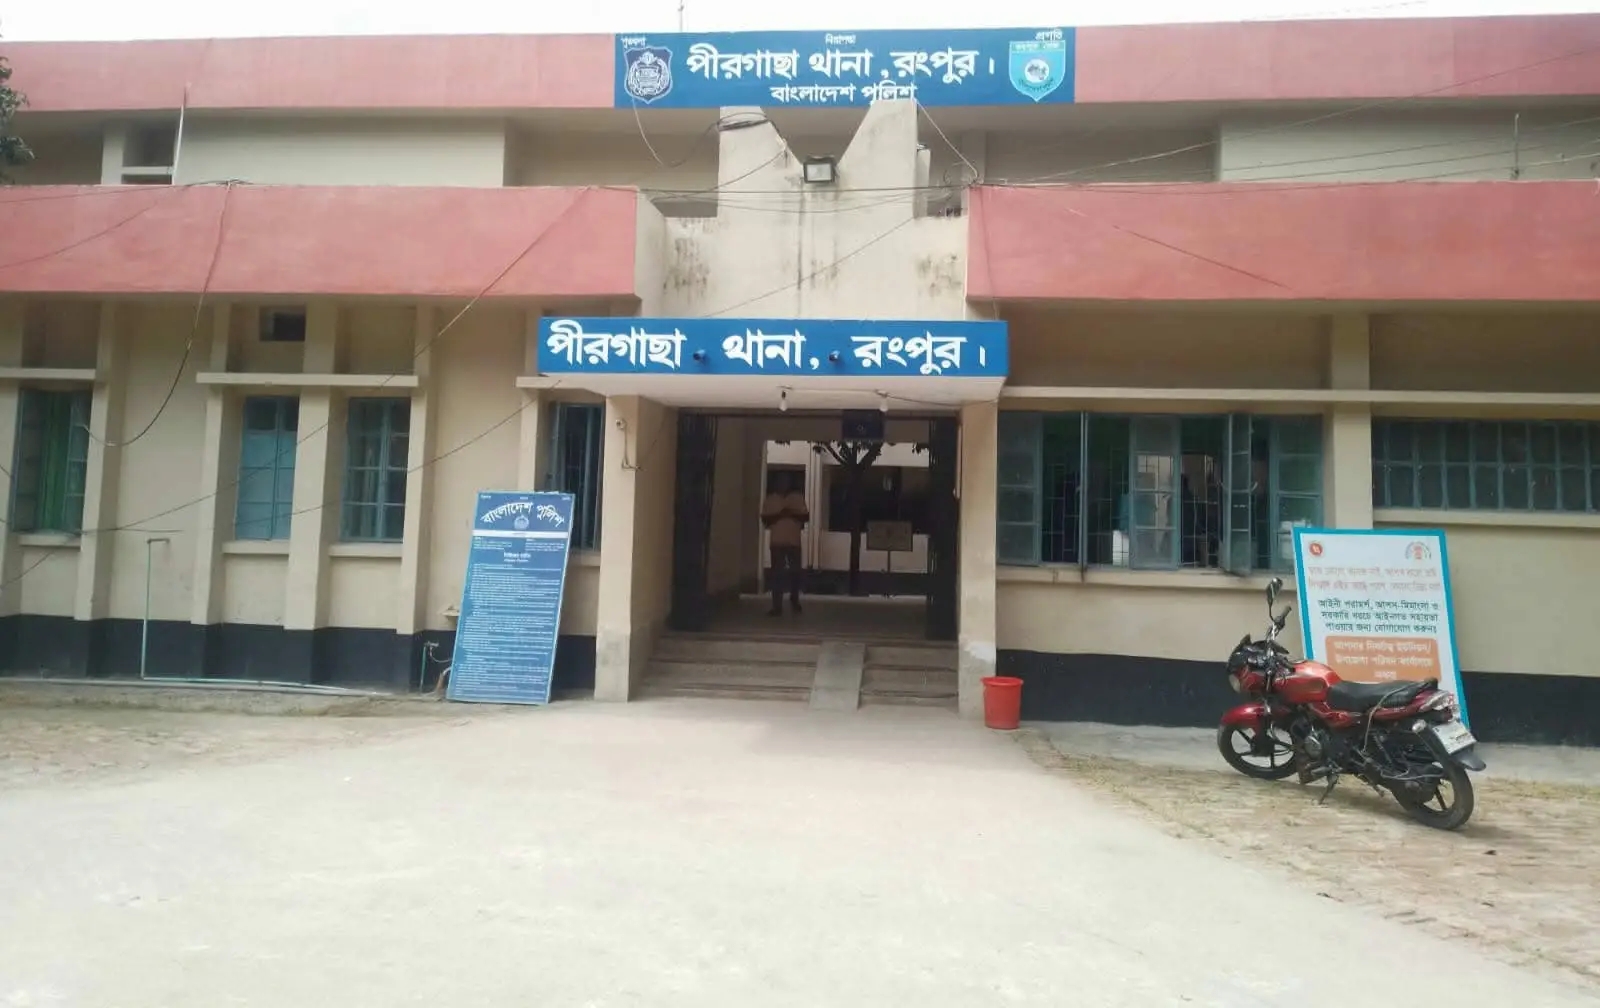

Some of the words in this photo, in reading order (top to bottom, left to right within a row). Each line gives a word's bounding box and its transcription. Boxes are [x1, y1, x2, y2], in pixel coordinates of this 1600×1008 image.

[686, 42, 800, 80] পীরগাছা
[769, 82, 856, 103] বাংলাদেশ
[546, 319, 687, 369] পীরগাছা
[480, 501, 535, 524] বাংলাদেশ
[536, 504, 565, 528] পুলিশ
